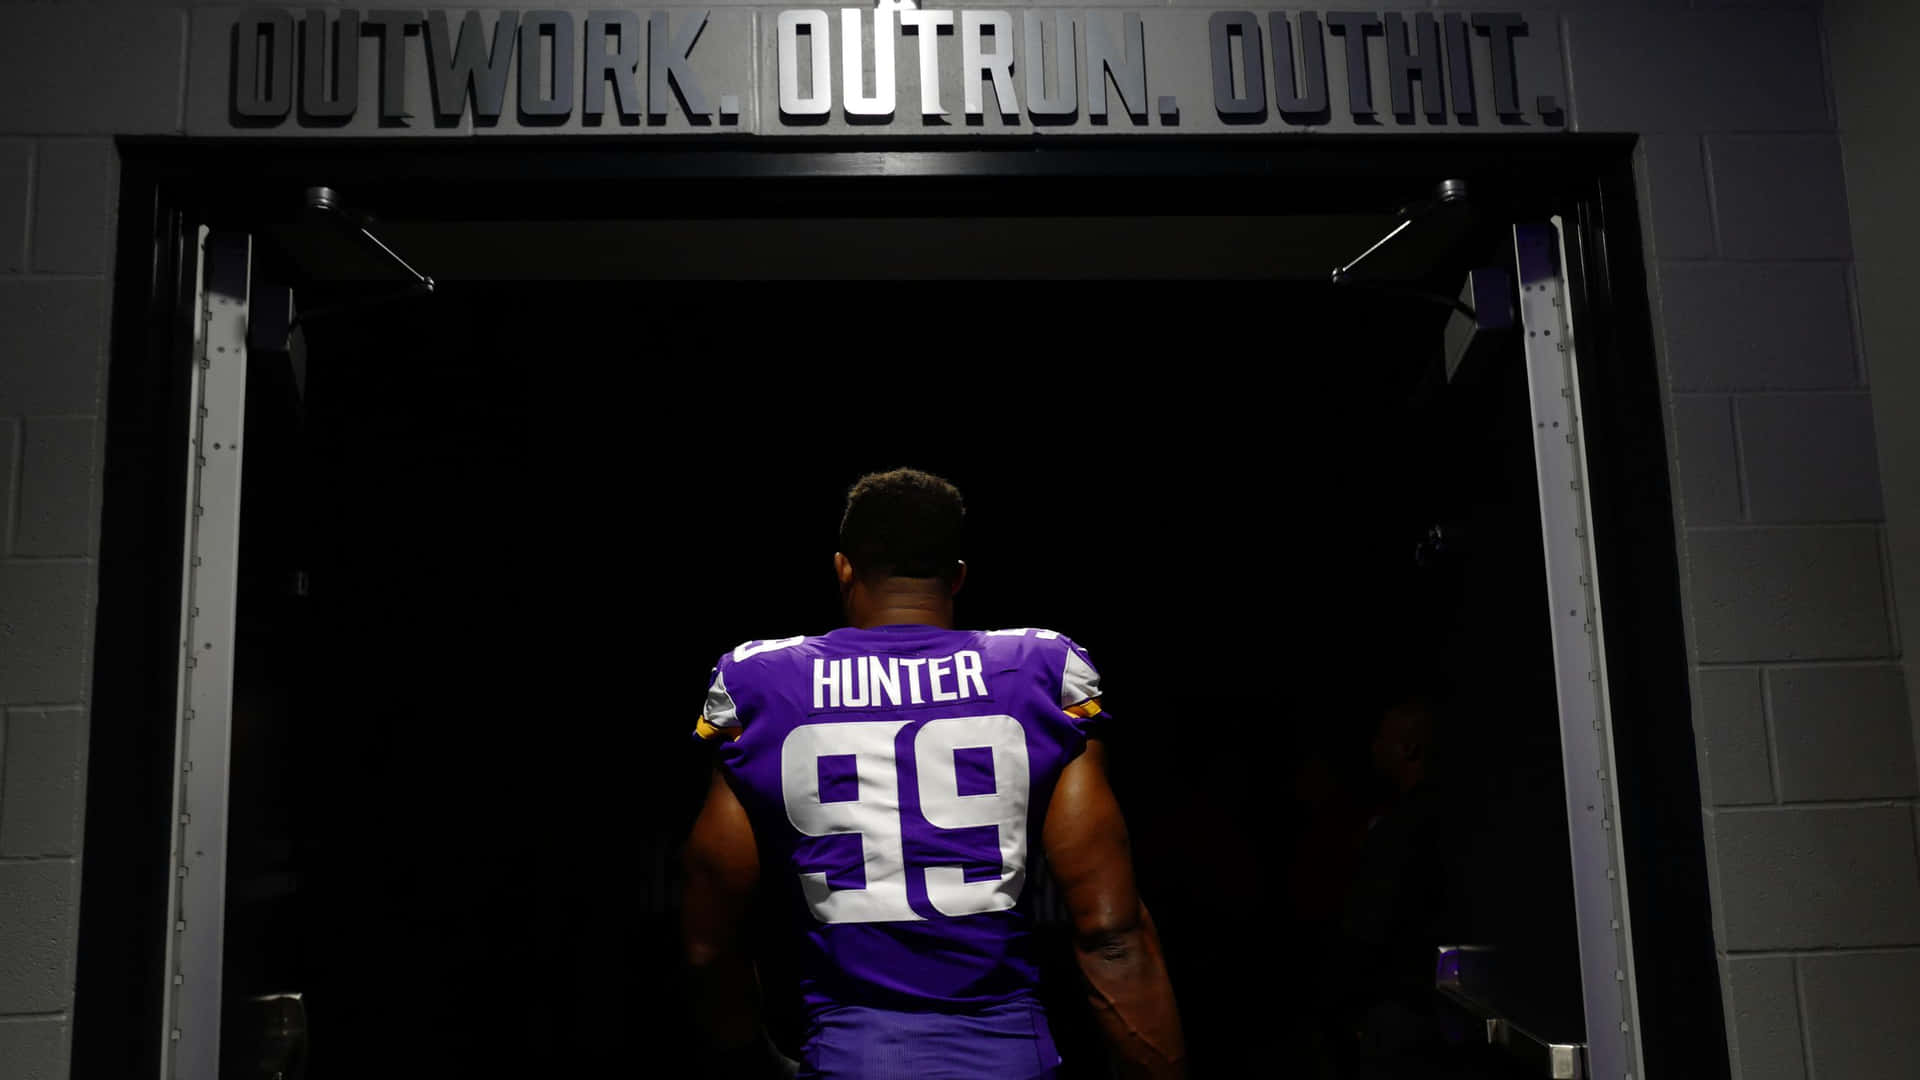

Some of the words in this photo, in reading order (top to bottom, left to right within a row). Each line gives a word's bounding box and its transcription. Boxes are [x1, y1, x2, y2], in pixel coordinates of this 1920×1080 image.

[233, 9, 739, 117] OUTWORK.
[777, 8, 1177, 117] OUTRUN.
[1208, 10, 1557, 117] OUTHIT.
[813, 650, 989, 709] HUNTER
[781, 714, 1030, 924] 99
